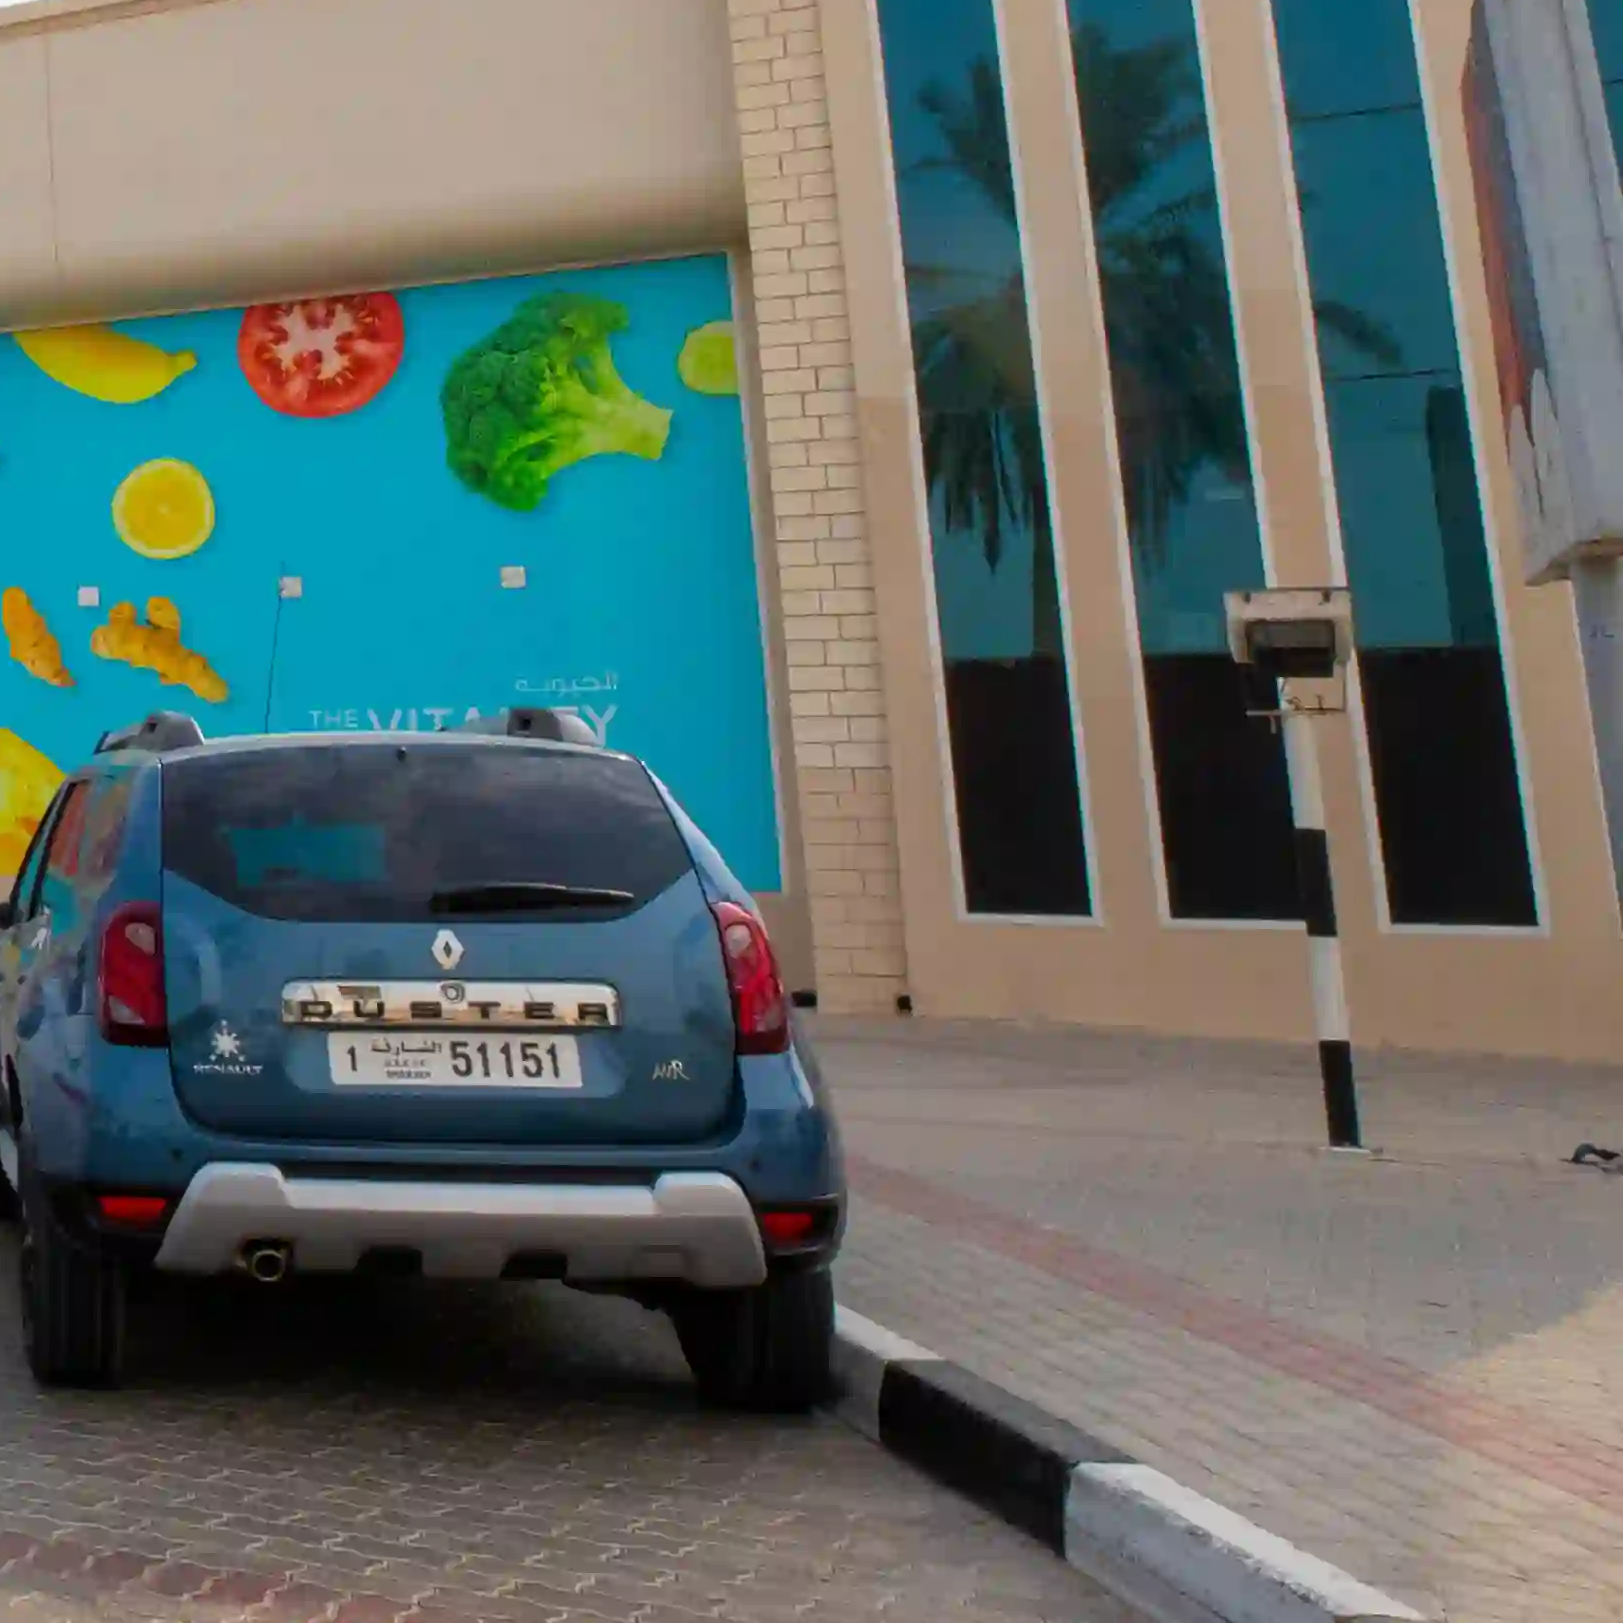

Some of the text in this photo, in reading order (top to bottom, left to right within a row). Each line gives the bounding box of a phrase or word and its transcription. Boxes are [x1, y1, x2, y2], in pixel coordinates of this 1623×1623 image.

[308, 710, 358, 728] THE
[300, 1000, 609, 1025] DUSTER
[347, 1045, 358, 1072] 1
[450, 1041, 560, 1079] 51151
